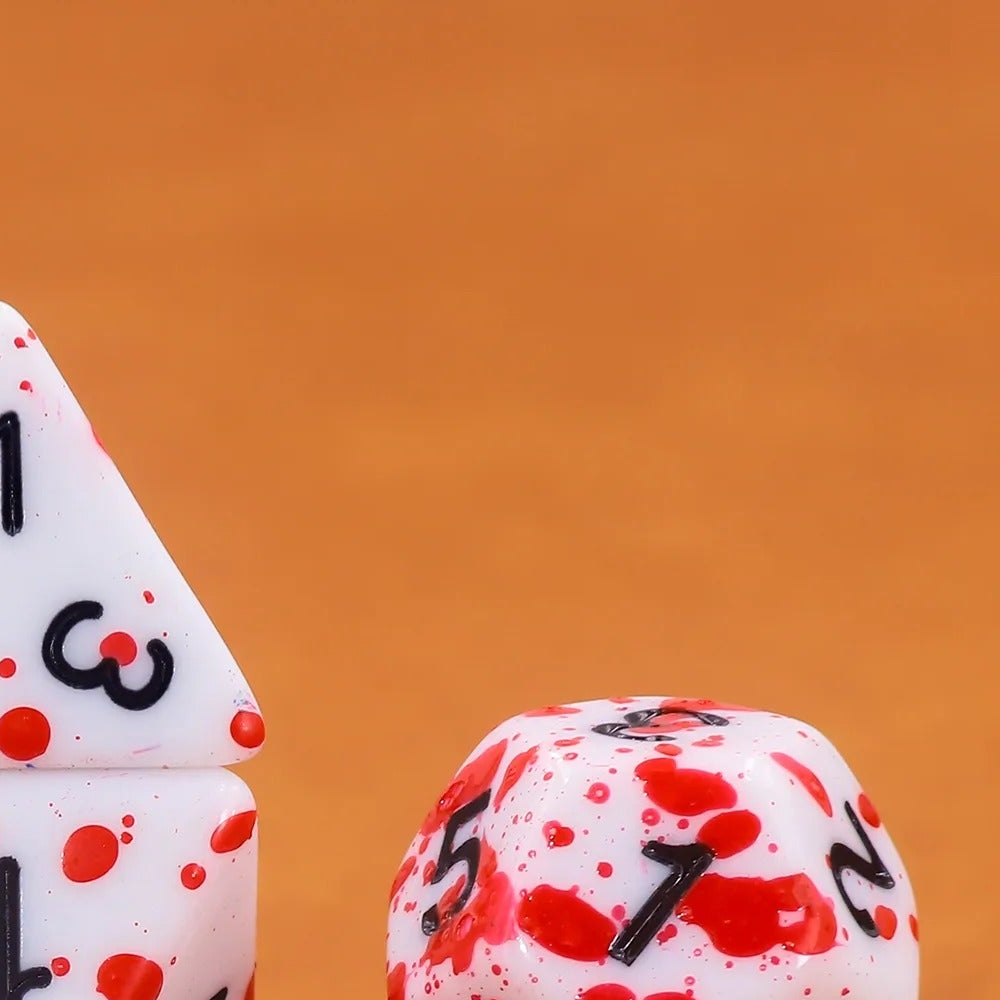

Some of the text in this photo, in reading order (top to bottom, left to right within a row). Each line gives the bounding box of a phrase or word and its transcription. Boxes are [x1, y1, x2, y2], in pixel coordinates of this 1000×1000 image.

[41, 600, 175, 712] 3
[420, 788, 491, 937] 5
[606, 840, 718, 968] 1
[829, 800, 896, 939] 2
